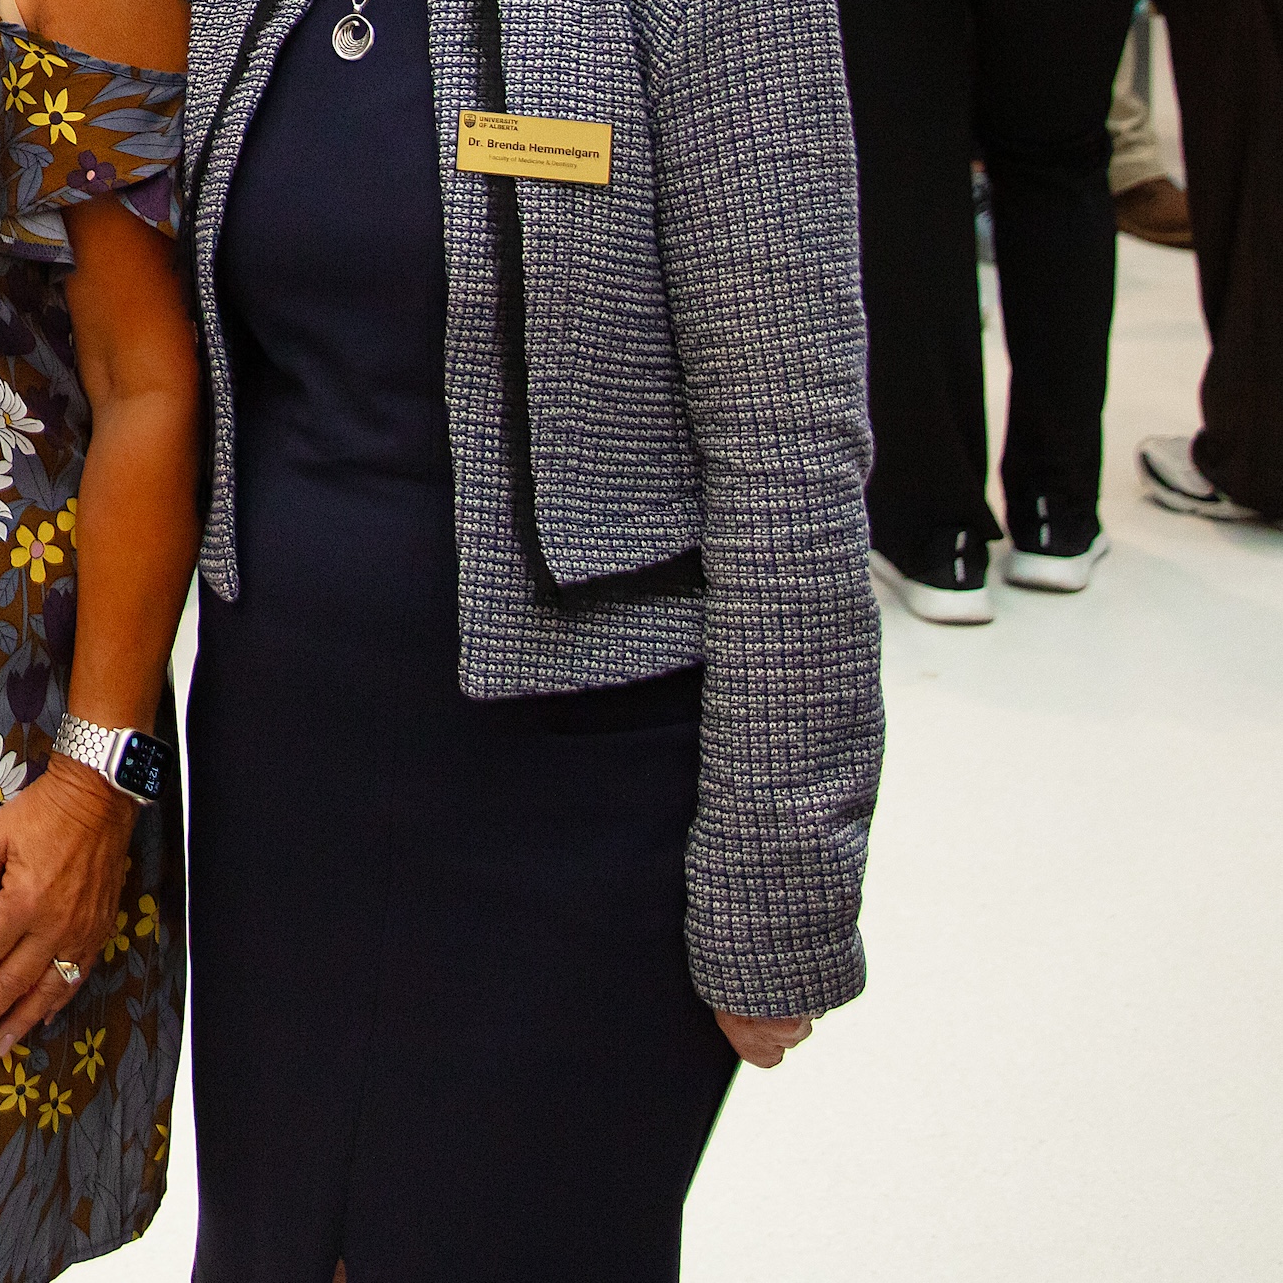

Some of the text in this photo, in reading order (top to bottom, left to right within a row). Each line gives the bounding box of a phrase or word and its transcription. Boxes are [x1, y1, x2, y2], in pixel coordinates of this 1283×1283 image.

[479, 116, 519, 125] UNIVERSITY
[488, 124, 519, 132] ALBERTA
[468, 137, 600, 159] Dr. Brenda Hemmelgarn
[488, 154, 509, 163] Faculty
[518, 157, 545, 166] Medicine
[145, 767, 158, 791] 12:12
